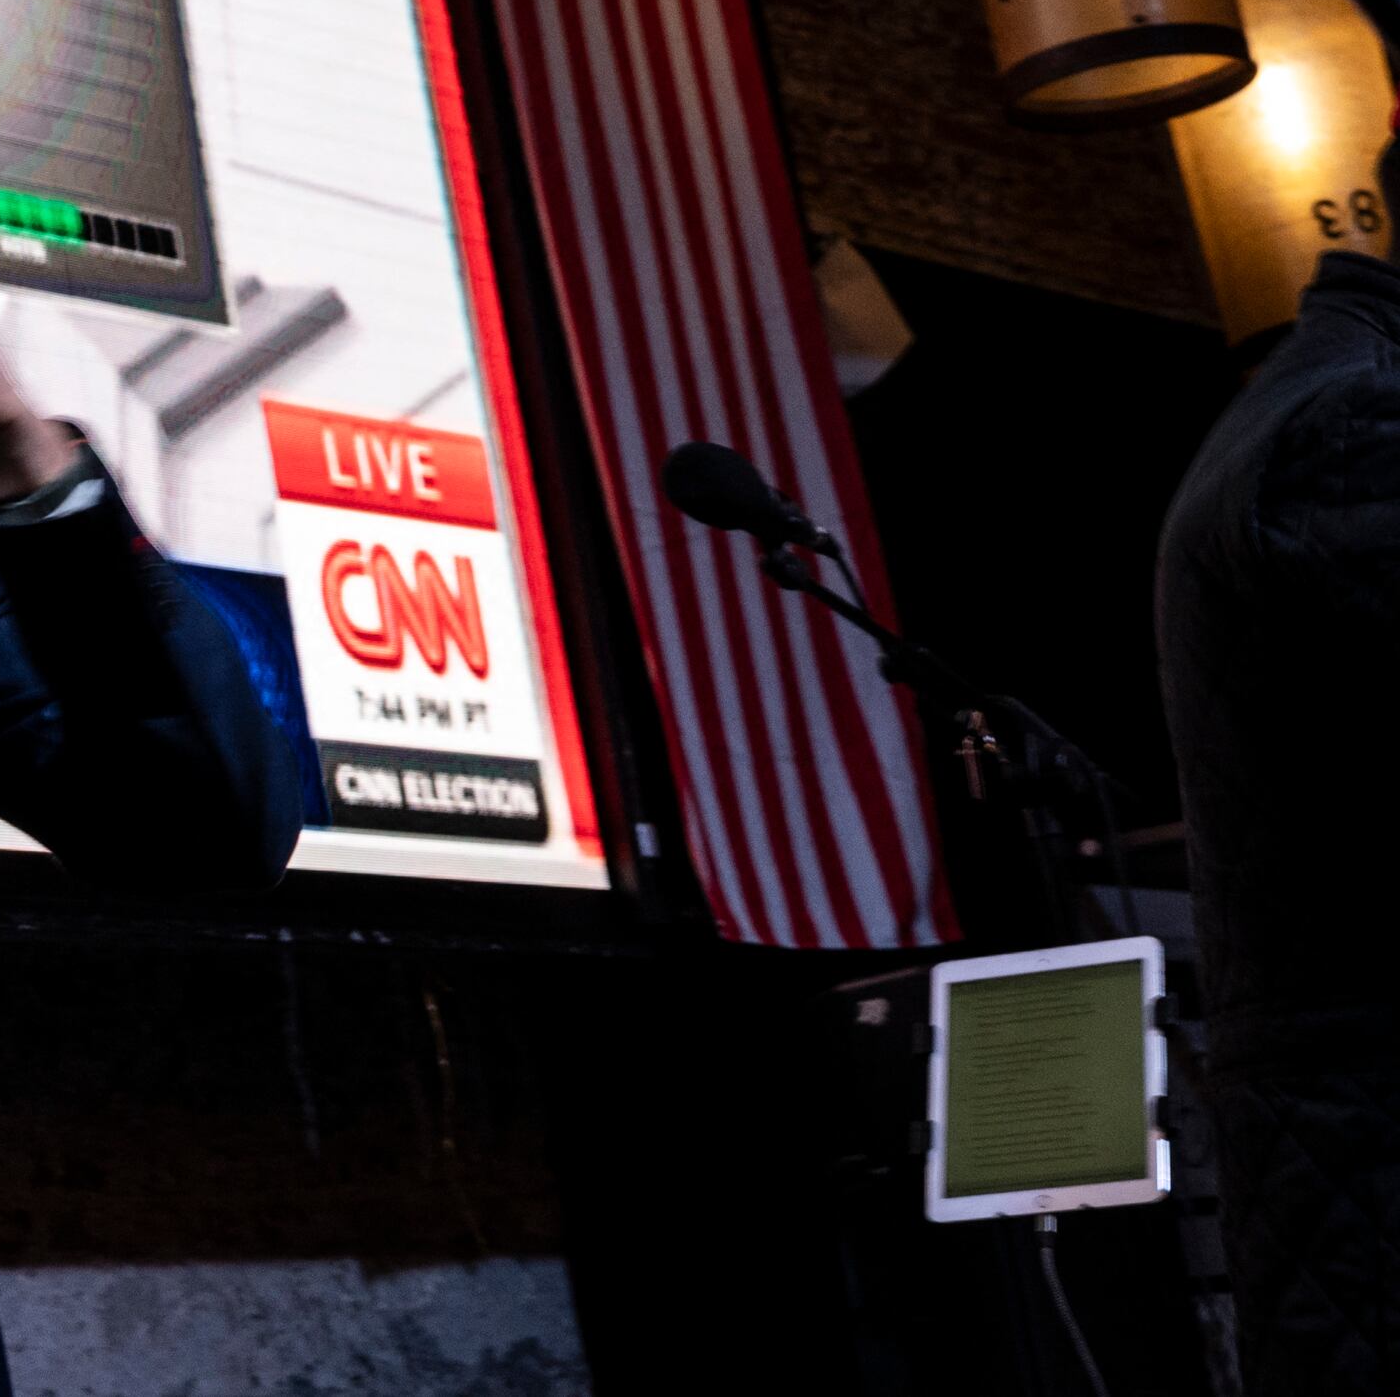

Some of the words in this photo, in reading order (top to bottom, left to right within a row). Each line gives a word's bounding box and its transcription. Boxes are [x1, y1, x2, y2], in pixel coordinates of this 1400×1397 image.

[322, 428, 443, 502] LIVE
[322, 539, 489, 681] CNN
[336, 763, 402, 807] CNN
[402, 770, 539, 819] ELECTION
